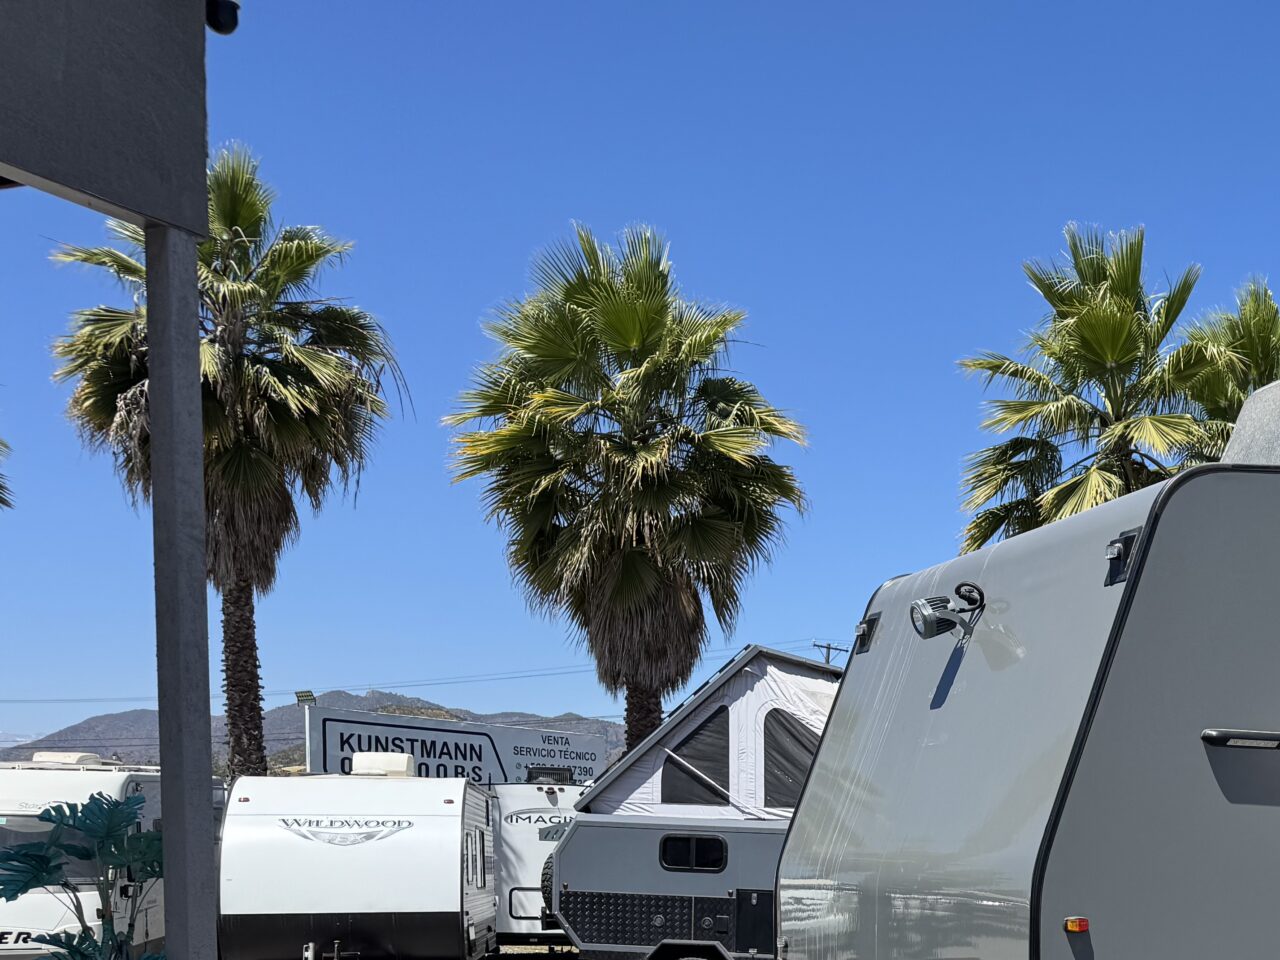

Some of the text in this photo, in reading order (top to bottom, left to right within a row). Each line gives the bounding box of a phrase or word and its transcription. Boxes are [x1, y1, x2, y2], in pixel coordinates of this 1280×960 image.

[339, 732, 482, 762] KUNSTMANN
[541, 735, 570, 746] VENTA
[513, 746, 597, 761] SERVICIO TÉCNICO
[340, 757, 483, 783] OOORS
[279, 818, 414, 829] WILDWOOD
